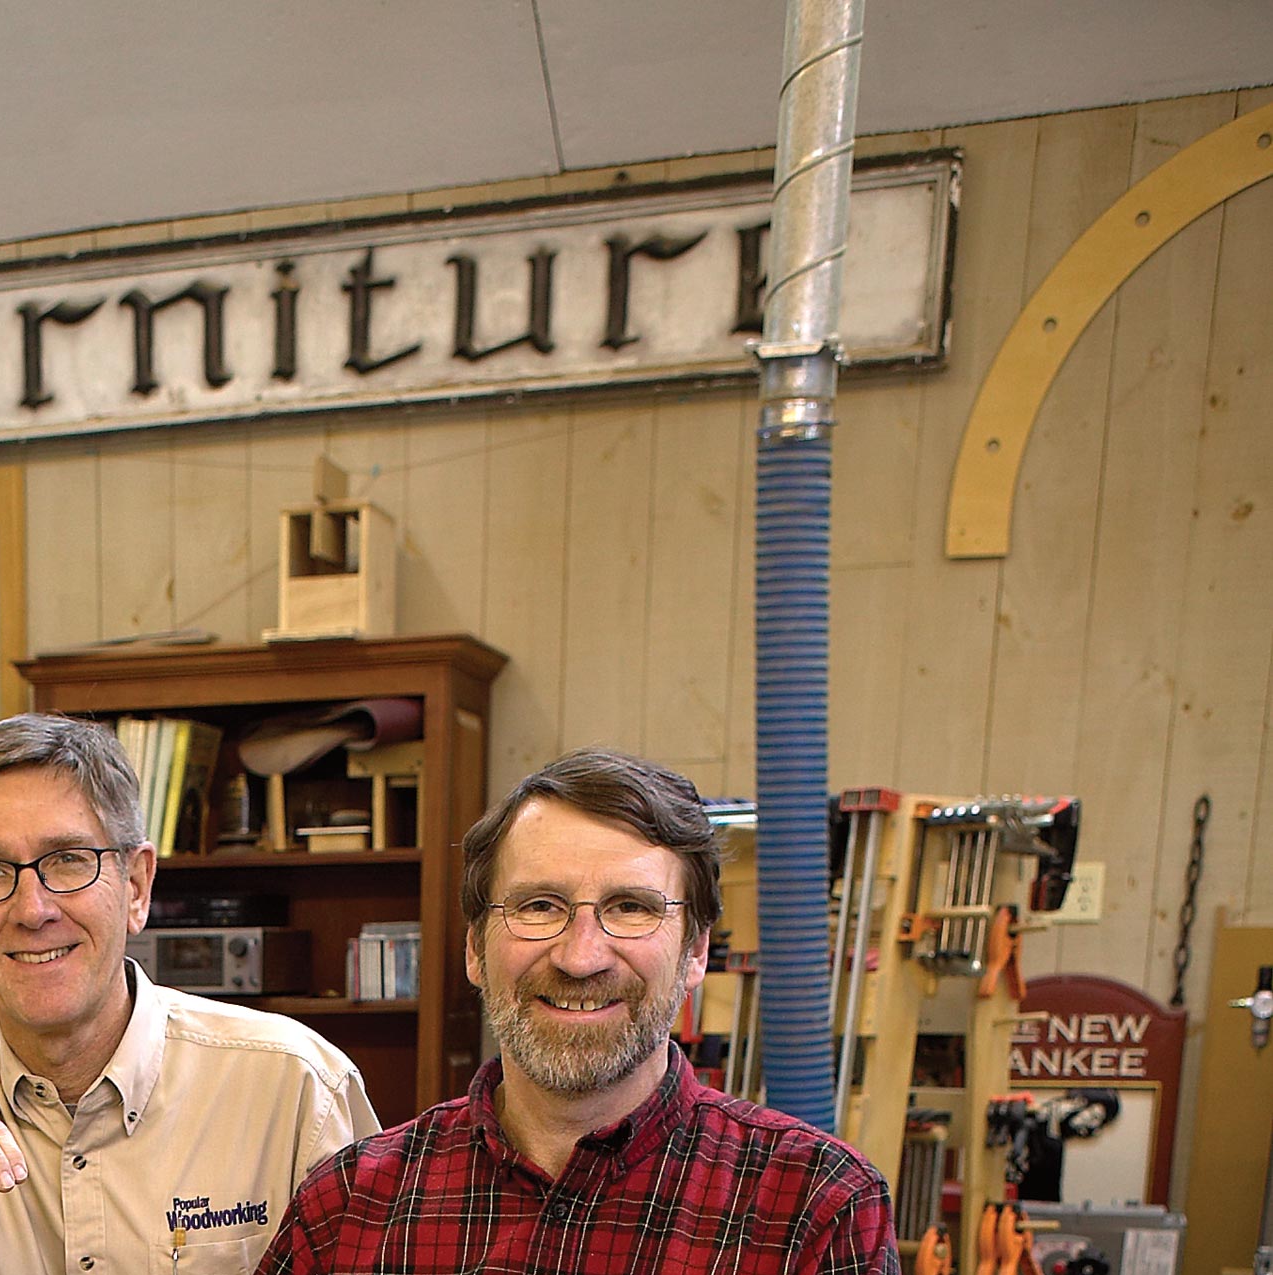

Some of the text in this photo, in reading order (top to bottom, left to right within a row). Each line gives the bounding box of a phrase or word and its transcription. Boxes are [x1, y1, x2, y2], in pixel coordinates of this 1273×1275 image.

[1048, 1013, 1152, 1044] NEW
[1009, 1047, 1149, 1077] ANKEE
[166, 1200, 269, 1232] Woodworking
[172, 1196, 210, 1212] Popular
